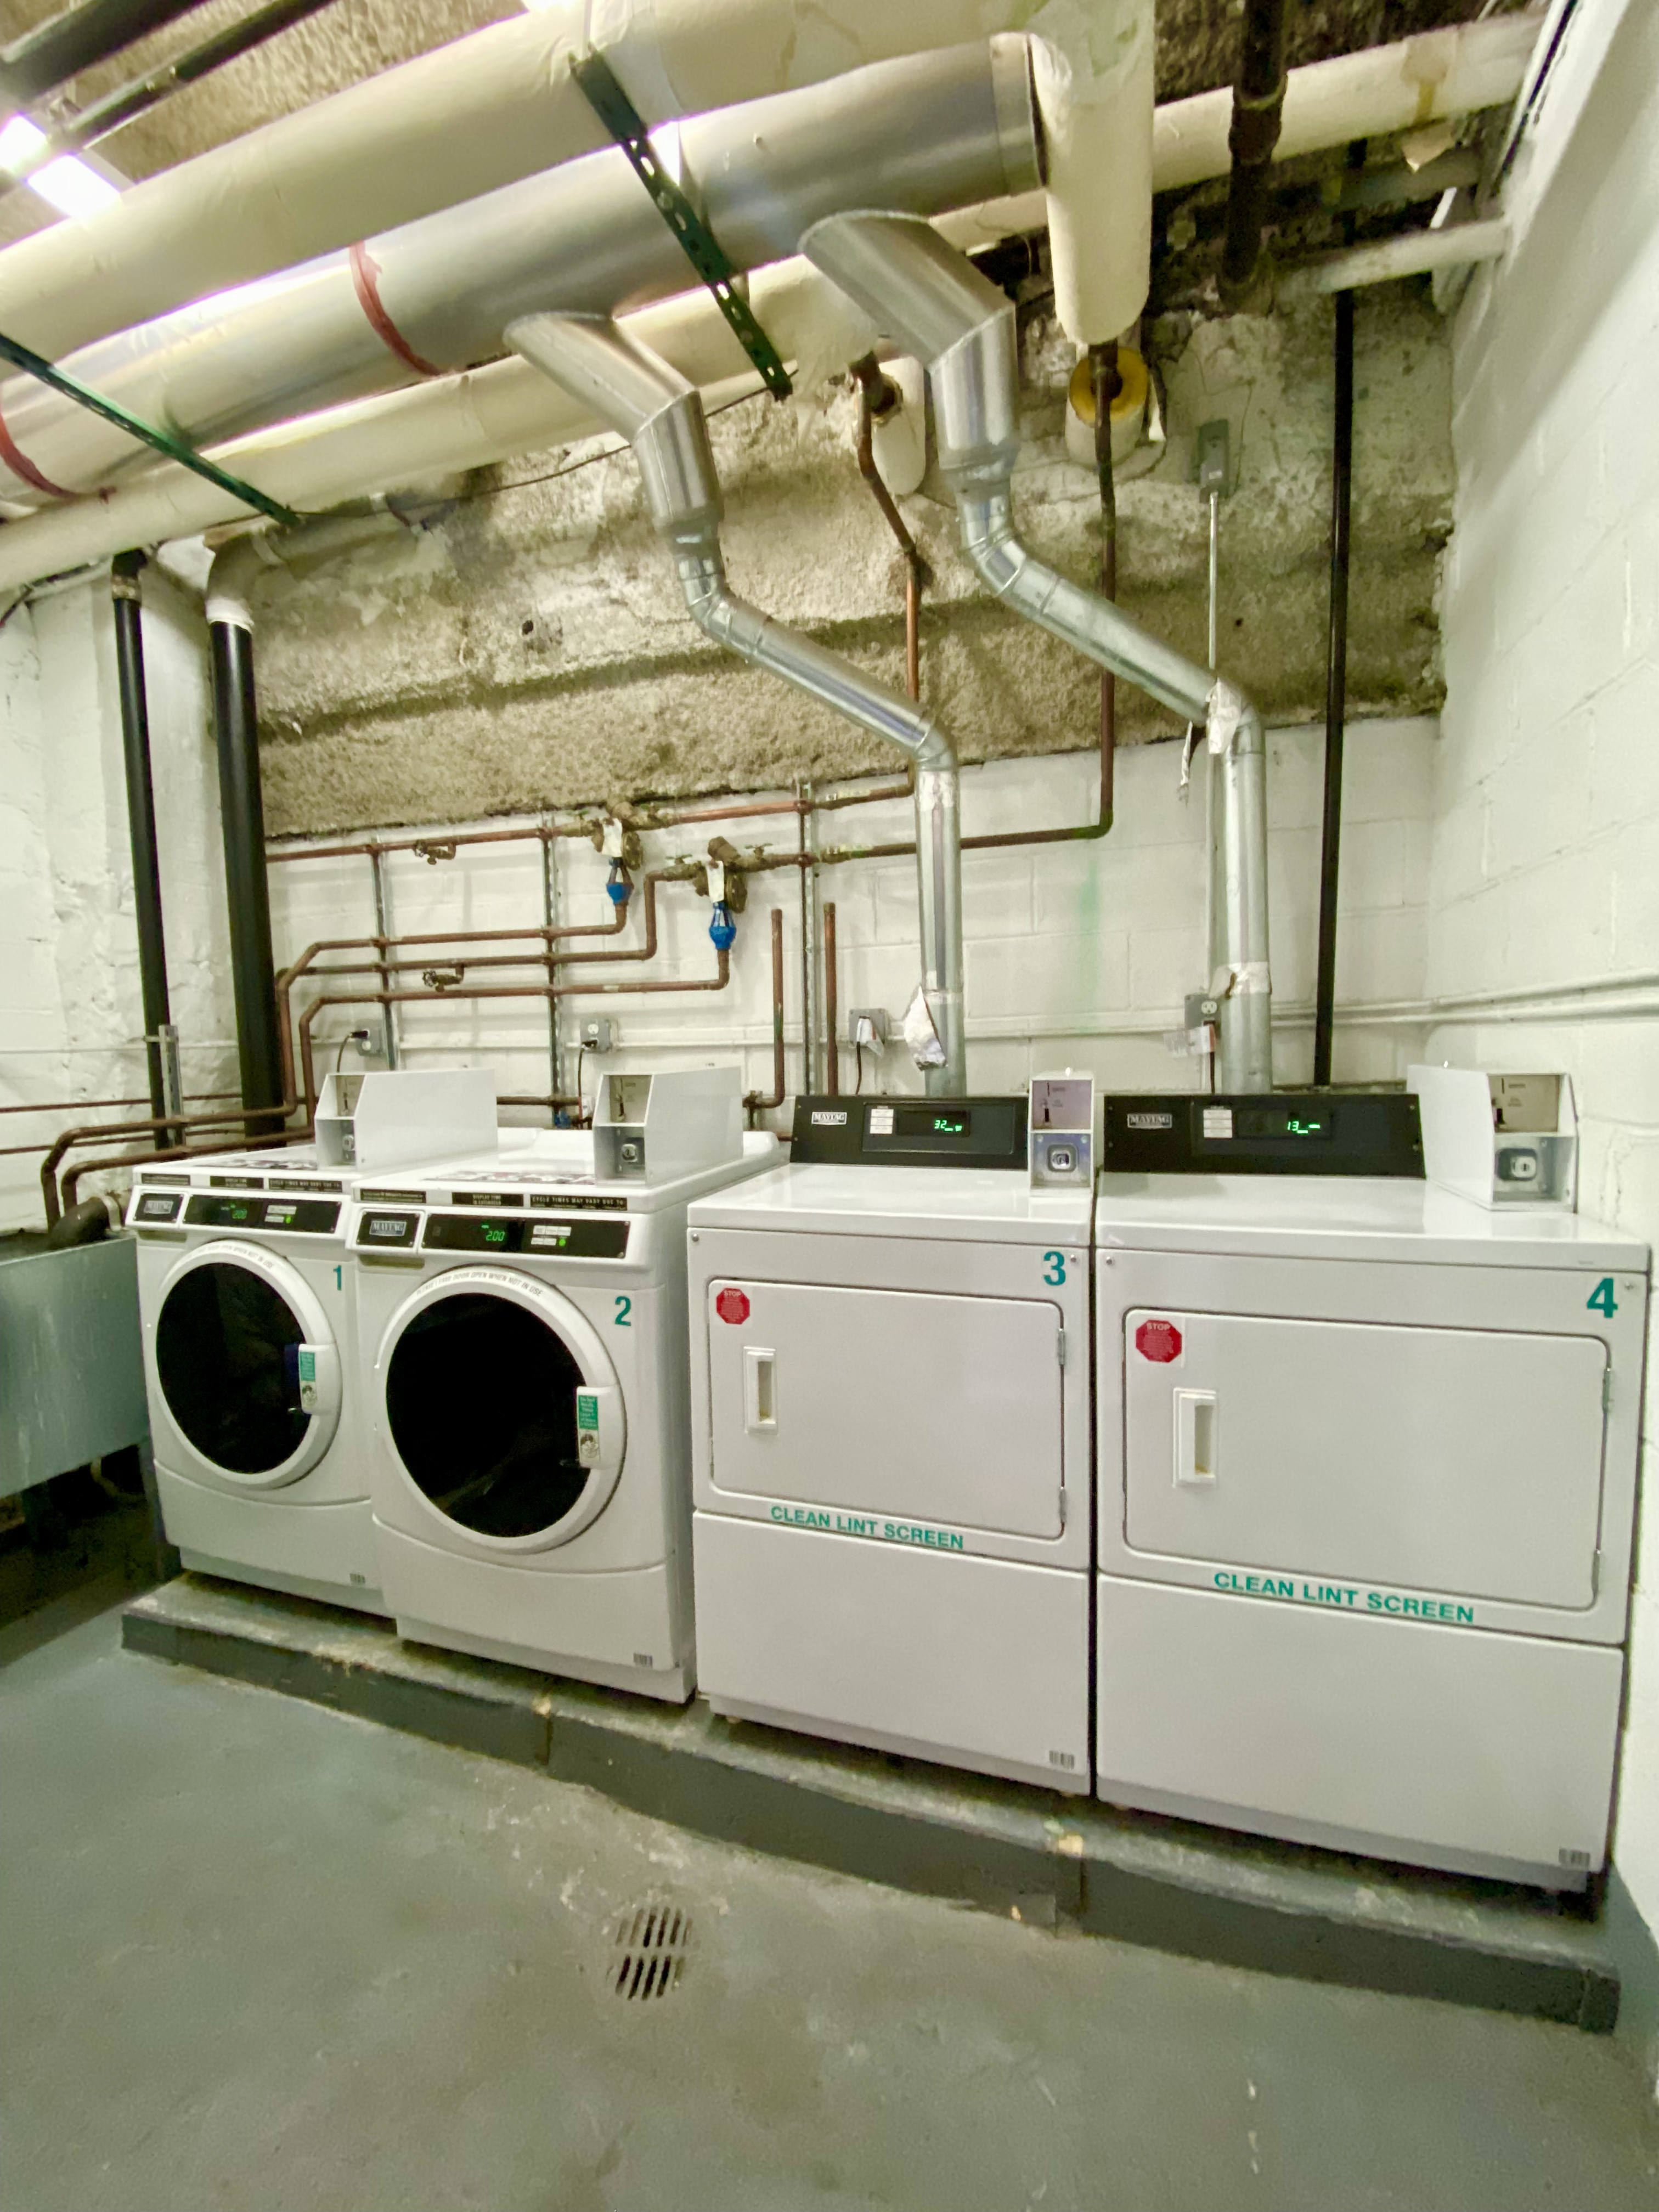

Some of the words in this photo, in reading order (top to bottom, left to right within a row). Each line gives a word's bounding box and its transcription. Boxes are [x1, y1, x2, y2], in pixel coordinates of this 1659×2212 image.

[1287, 1121, 1299, 1131] 13
[373, 1222, 403, 1231] MAYTAG
[333, 1265, 342, 1290] 1
[453, 1272, 469, 1280] DOOR
[489, 1273, 507, 1282] WHEN
[508, 1277, 522, 1285] NOT
[529, 1286, 543, 1296] USE
[1043, 1251, 1066, 1286] 3
[614, 1296, 632, 1327] 2
[1587, 1277, 1618, 1318] 4
[771, 1506, 830, 1528] CLEAN
[837, 1515, 877, 1535] LINT
[884, 1523, 963, 1550] SCREEN
[1214, 1572, 1294, 1598] CLEAN
[1304, 1584, 1358, 1606] LINT
[1367, 1593, 1474, 1623] SCREEN
